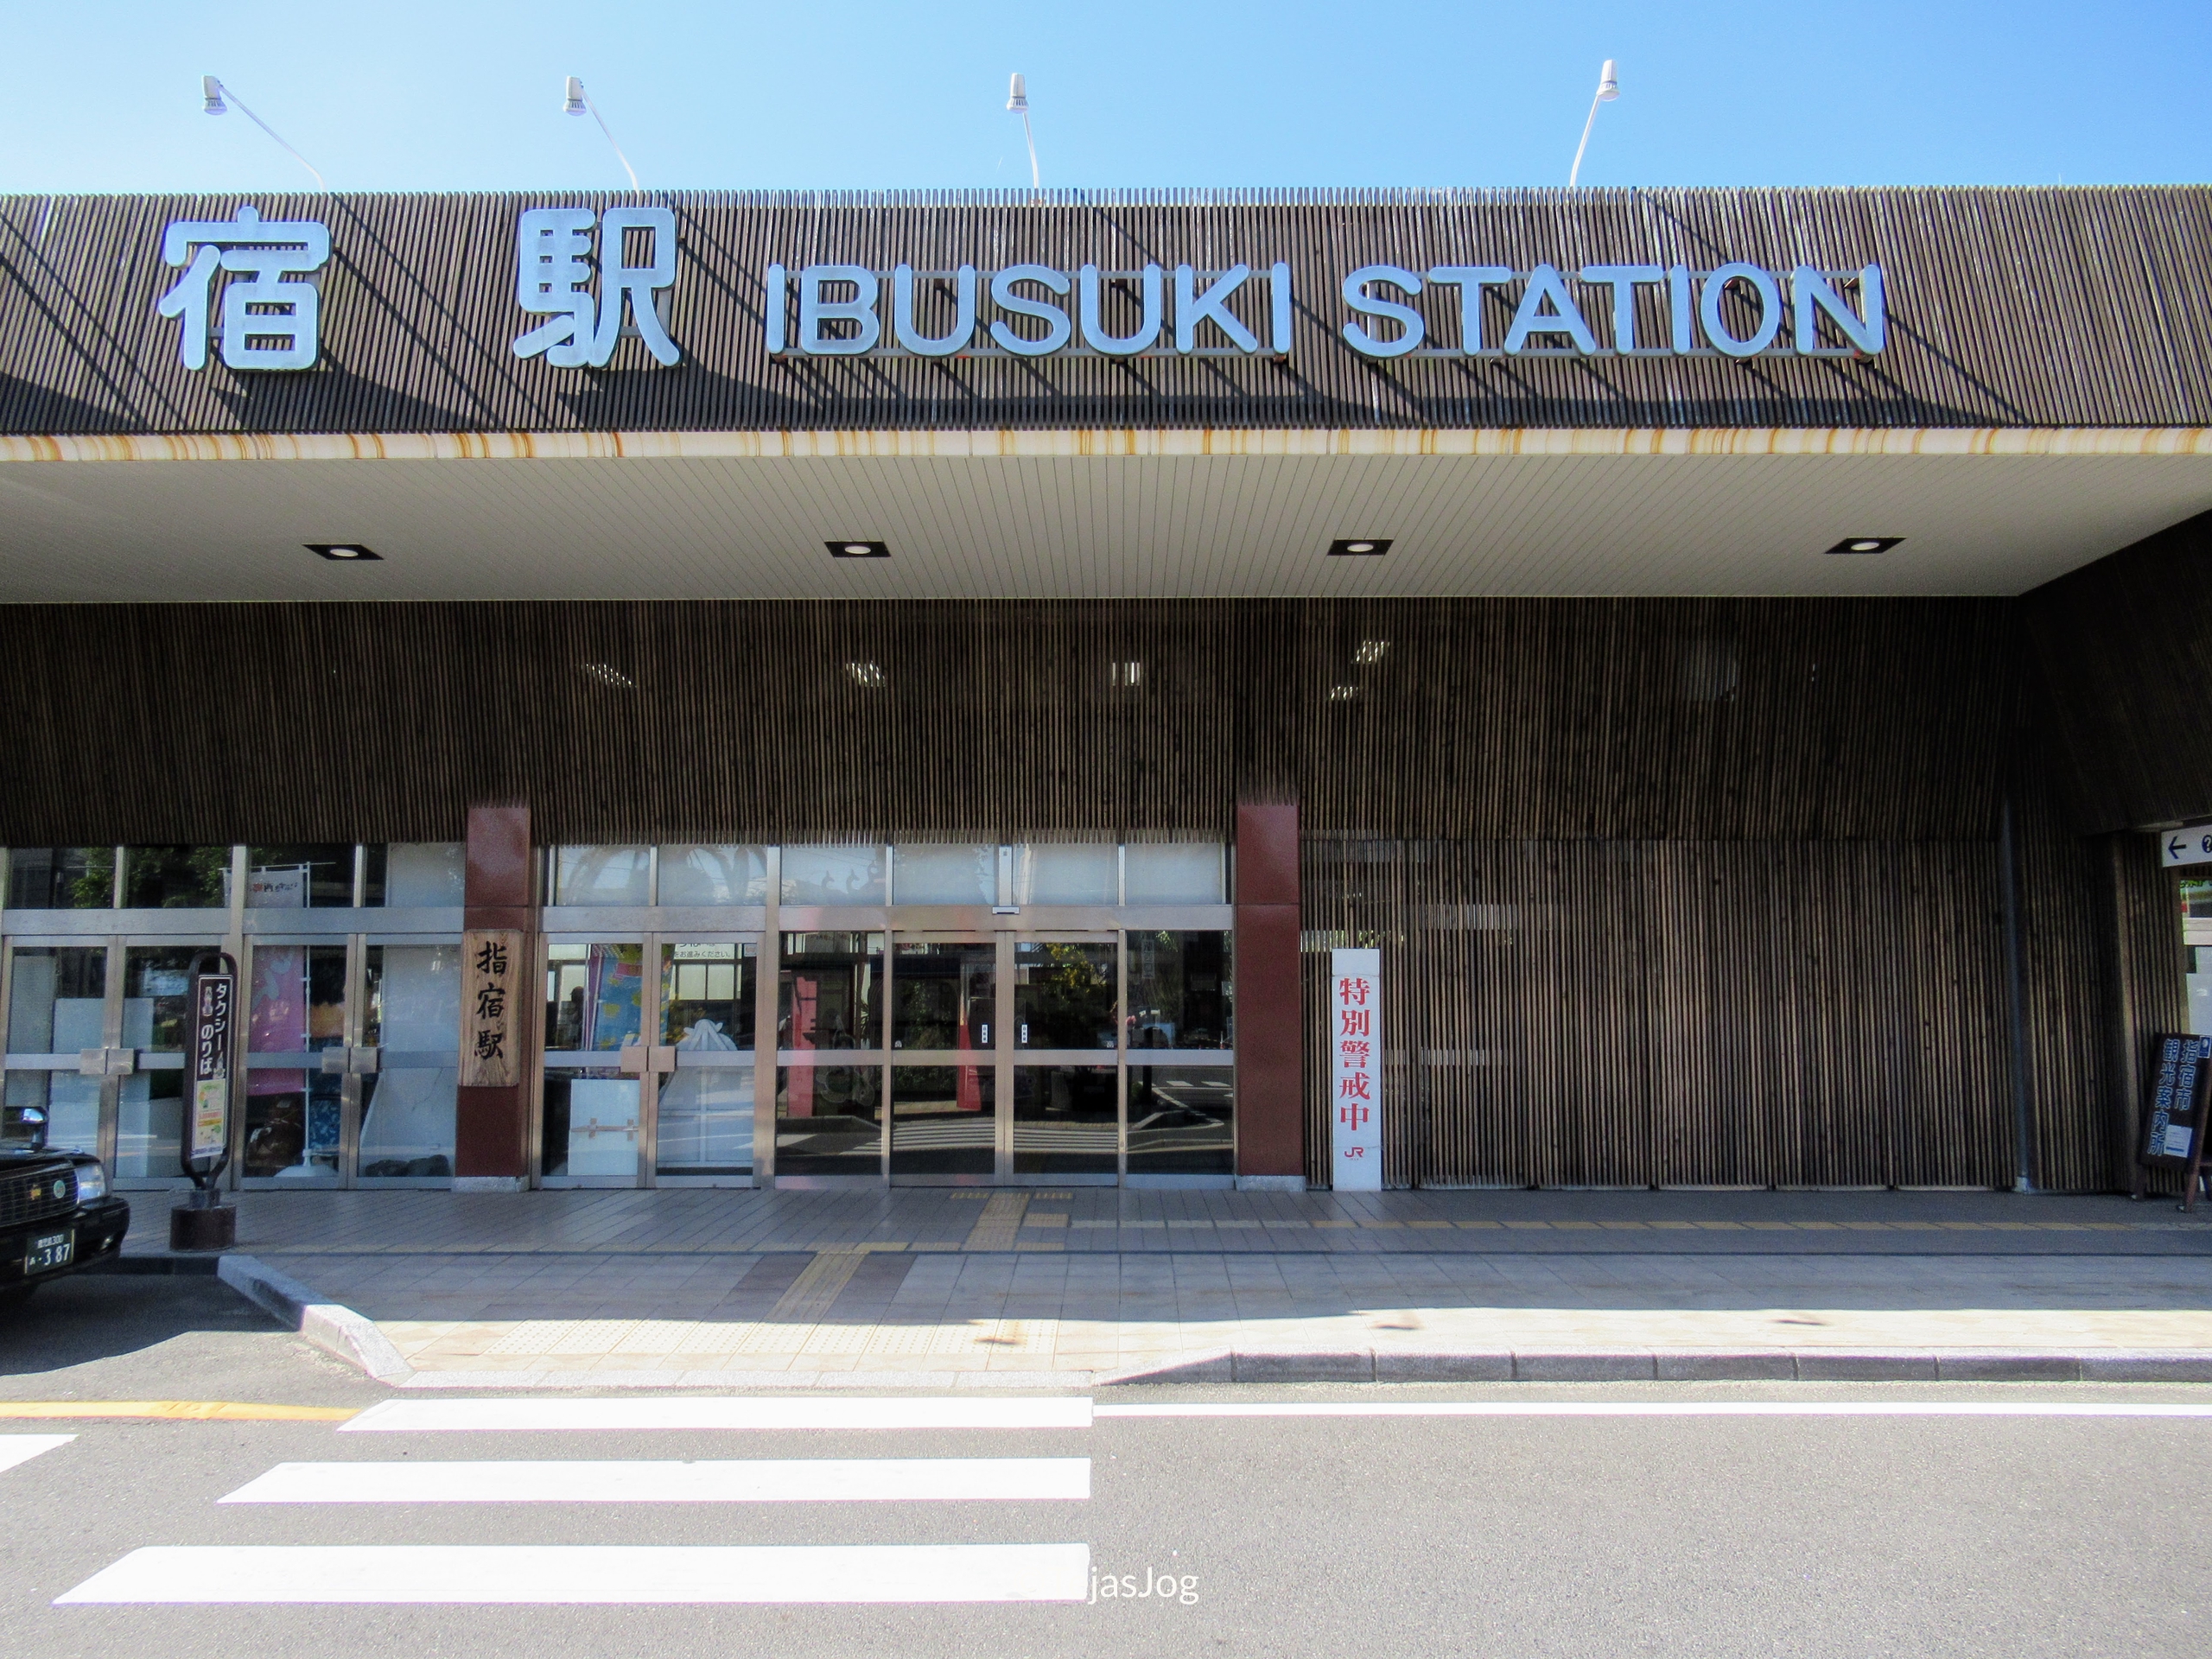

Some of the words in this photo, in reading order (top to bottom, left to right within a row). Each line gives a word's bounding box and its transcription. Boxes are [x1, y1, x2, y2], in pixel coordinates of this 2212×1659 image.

[767, 263, 1292, 356] IBUSUKI
[1341, 263, 1885, 357] STATION
[214, 982, 228, 1051] タクシー
[474, 940, 508, 1060] 指宿駅
[200, 1023, 214, 1075] のりば
[1338, 977, 1371, 1131] 特別警戒中
[2175, 1039, 2199, 1110] 指宿市
[2149, 1039, 2180, 1156] 観光案内所
[1344, 1147, 1364, 1159] JR
